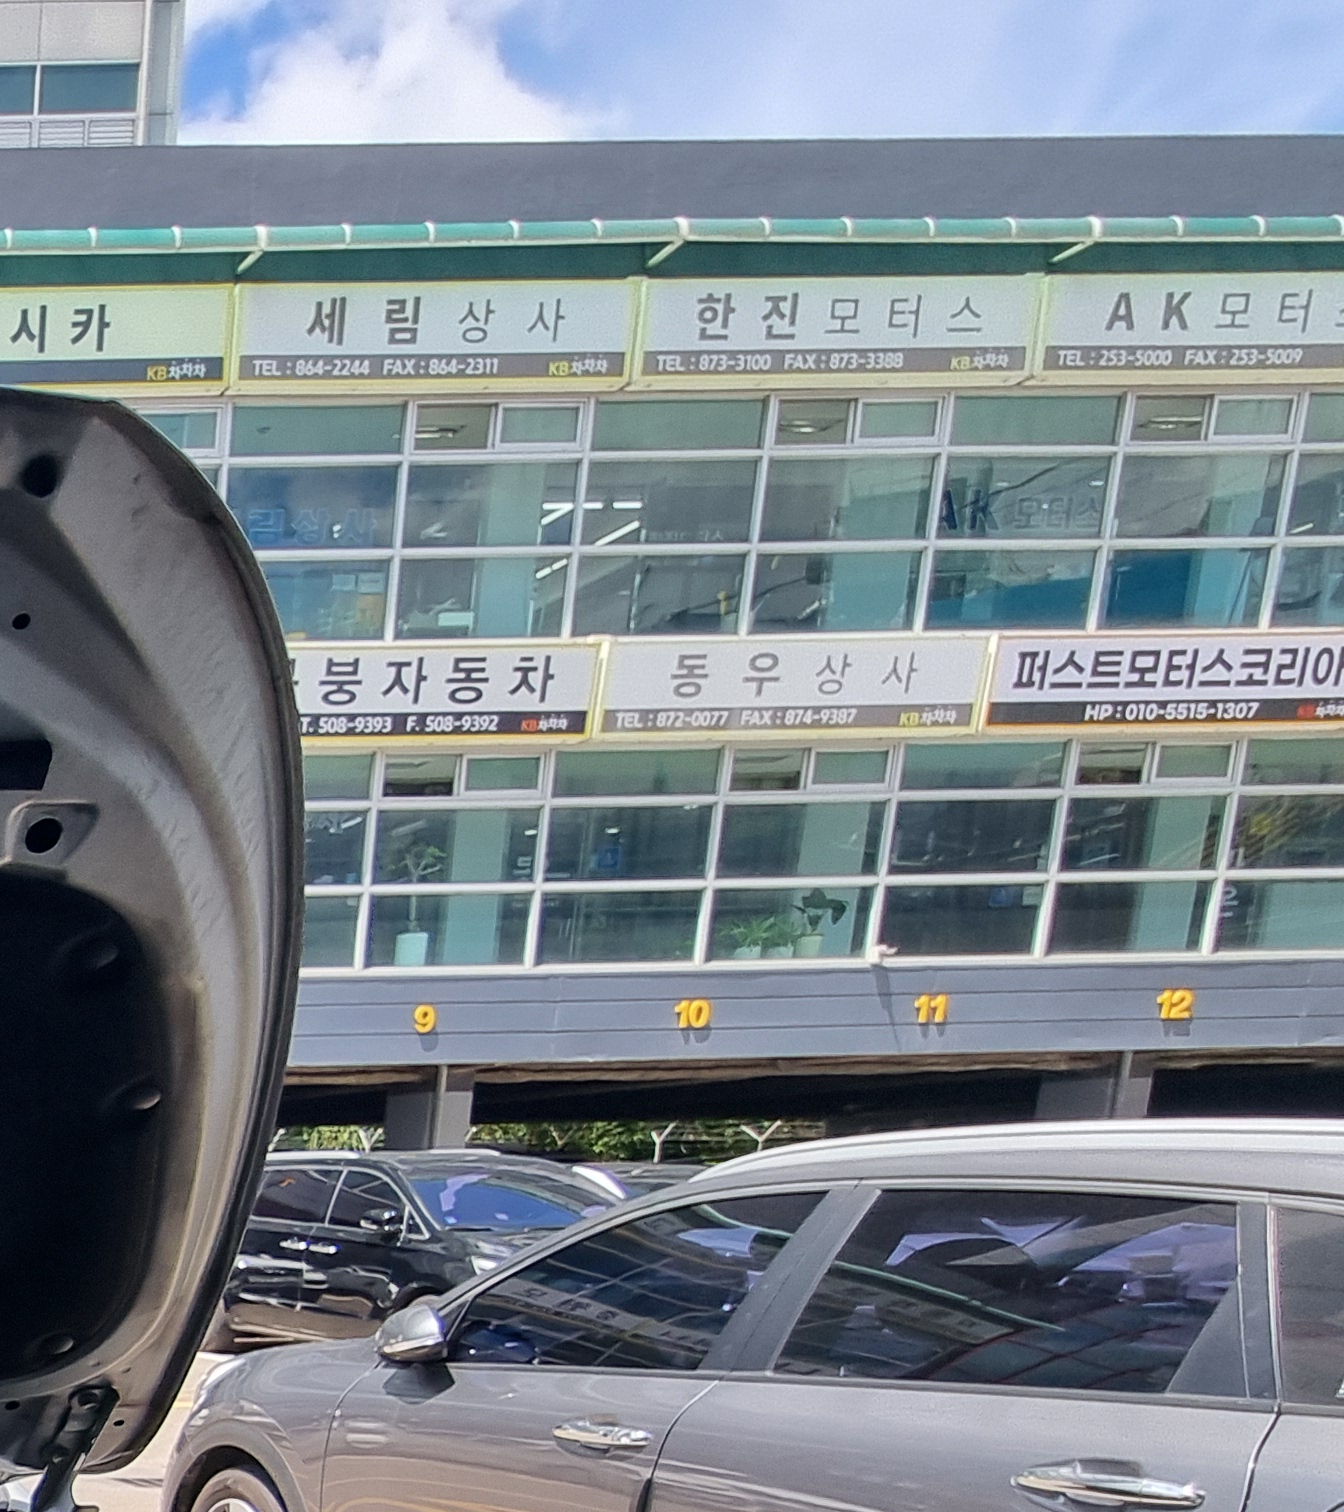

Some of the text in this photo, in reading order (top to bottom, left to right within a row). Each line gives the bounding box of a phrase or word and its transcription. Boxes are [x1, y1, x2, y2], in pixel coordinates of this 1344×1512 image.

[306, 296, 566, 346] 세림상사
[697, 292, 984, 341] 한진모터스
[290, 653, 556, 706] 붕자동차
[670, 651, 919, 698] 동우상사
[1012, 646, 1344, 692] 퍼스트모터스코리아
[318, 715, 393, 734] 508-9393
[424, 714, 499, 733] 508-9392
[413, 1004, 438, 1034] 9
[674, 998, 711, 1029] 10
[914, 993, 948, 1024] 11
[1156, 988, 1195, 1019] 12
